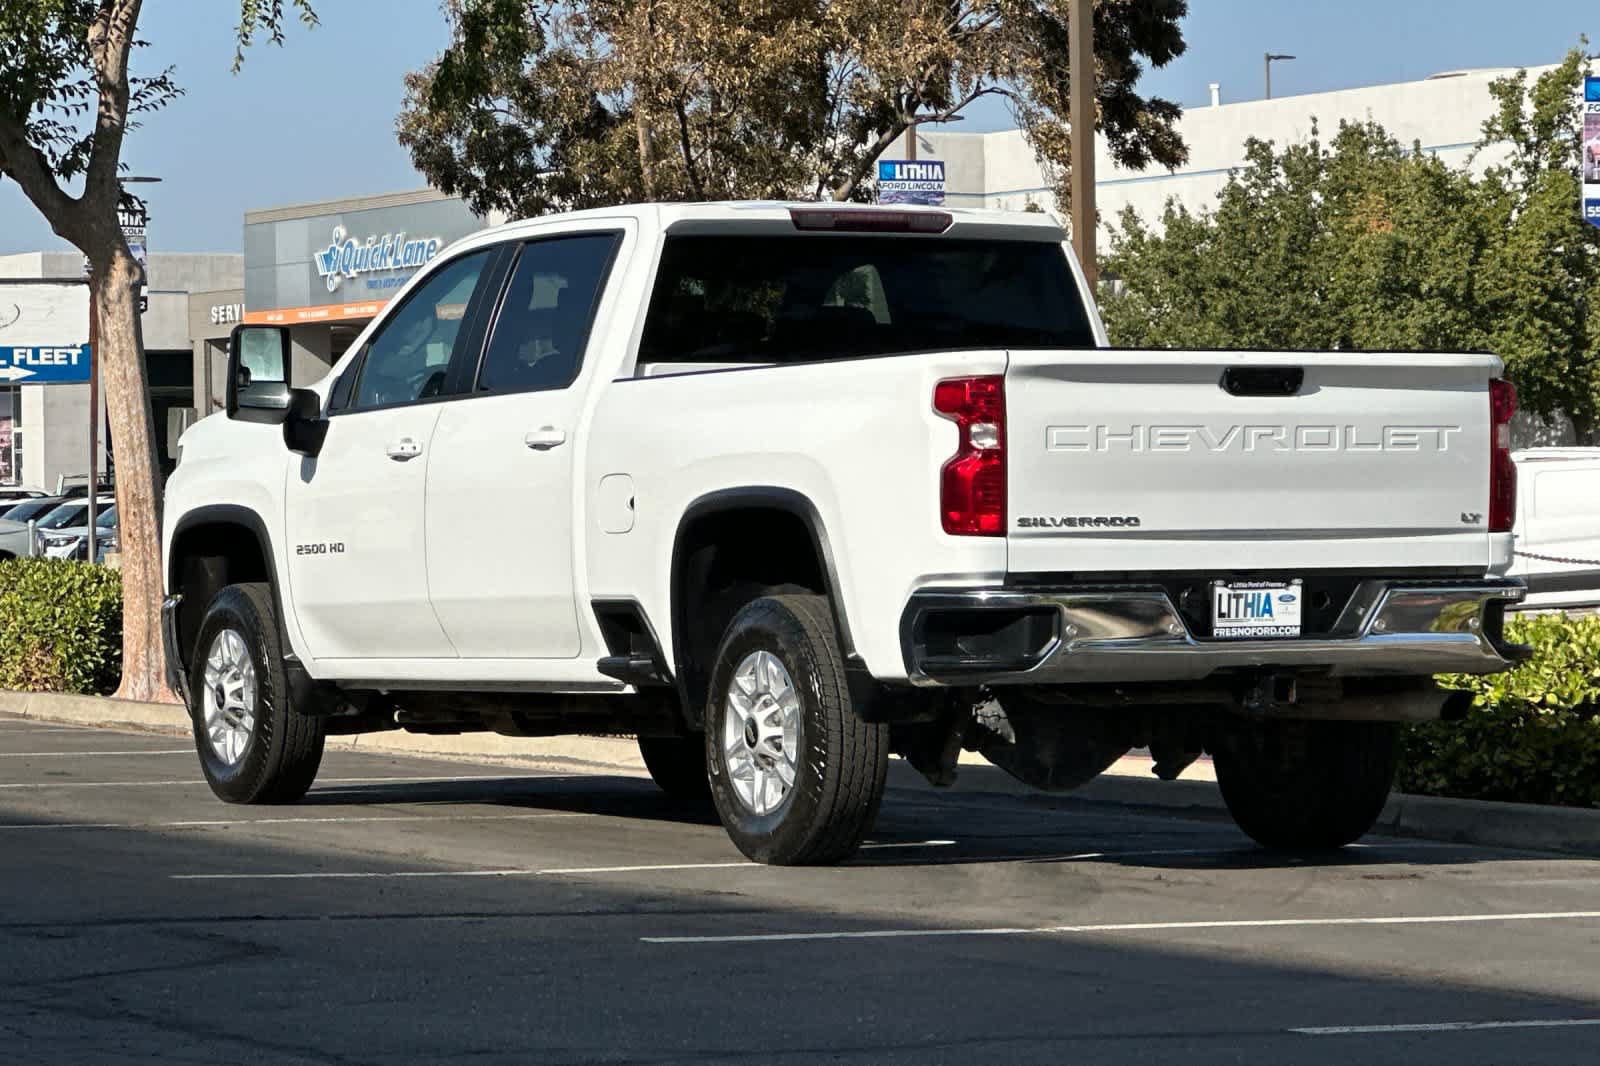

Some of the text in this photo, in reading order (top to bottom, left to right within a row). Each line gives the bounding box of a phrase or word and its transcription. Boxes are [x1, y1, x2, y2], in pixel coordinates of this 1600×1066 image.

[895, 164, 944, 179] LITHIA
[882, 182, 943, 190] FORD LINCOLN
[117, 211, 144, 226] HIA
[341, 233, 438, 273] Quick Lane
[13, 348, 83, 365] FLEET
[1046, 425, 1462, 452] CHEVROLET
[1017, 516, 1141, 528] SILVERADO
[1461, 512, 1482, 524] LT
[296, 542, 345, 555] 2500 HD
[1217, 592, 1274, 618] LITHIA
[1213, 626, 1300, 638] FRESNOFORD.COM
